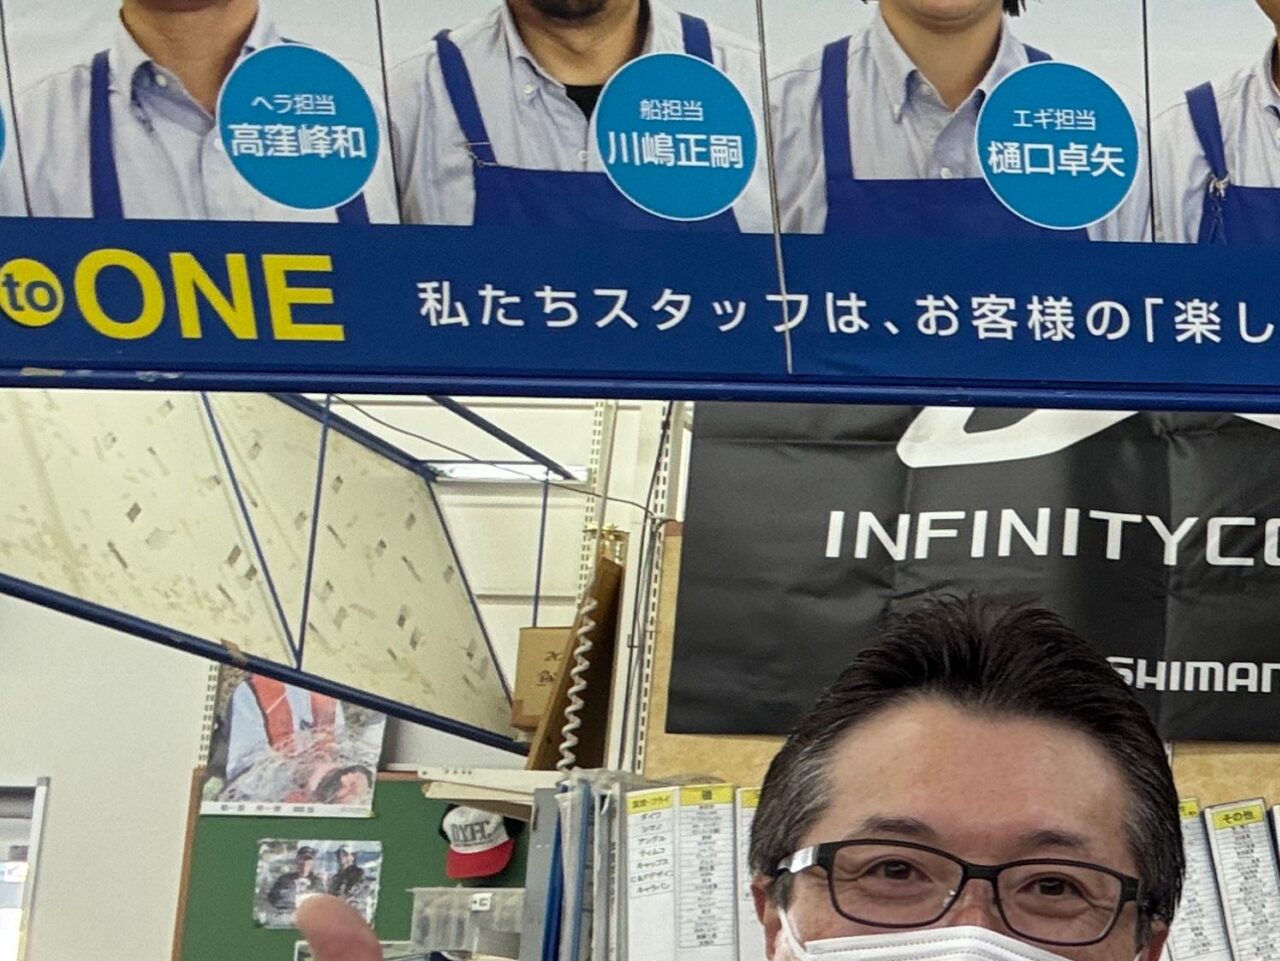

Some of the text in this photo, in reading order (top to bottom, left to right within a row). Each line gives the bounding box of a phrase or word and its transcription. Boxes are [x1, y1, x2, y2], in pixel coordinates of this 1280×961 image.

[251, 94, 336, 116] ヘラ担当
[640, 99, 704, 122] 船担当
[1012, 108, 1097, 132] エギ担当
[229, 124, 368, 160] 高窪峰和
[607, 131, 744, 169] 川嶋正嗣
[987, 141, 1126, 178] 樋口卓矢
[2, 247, 346, 342] to ONE
